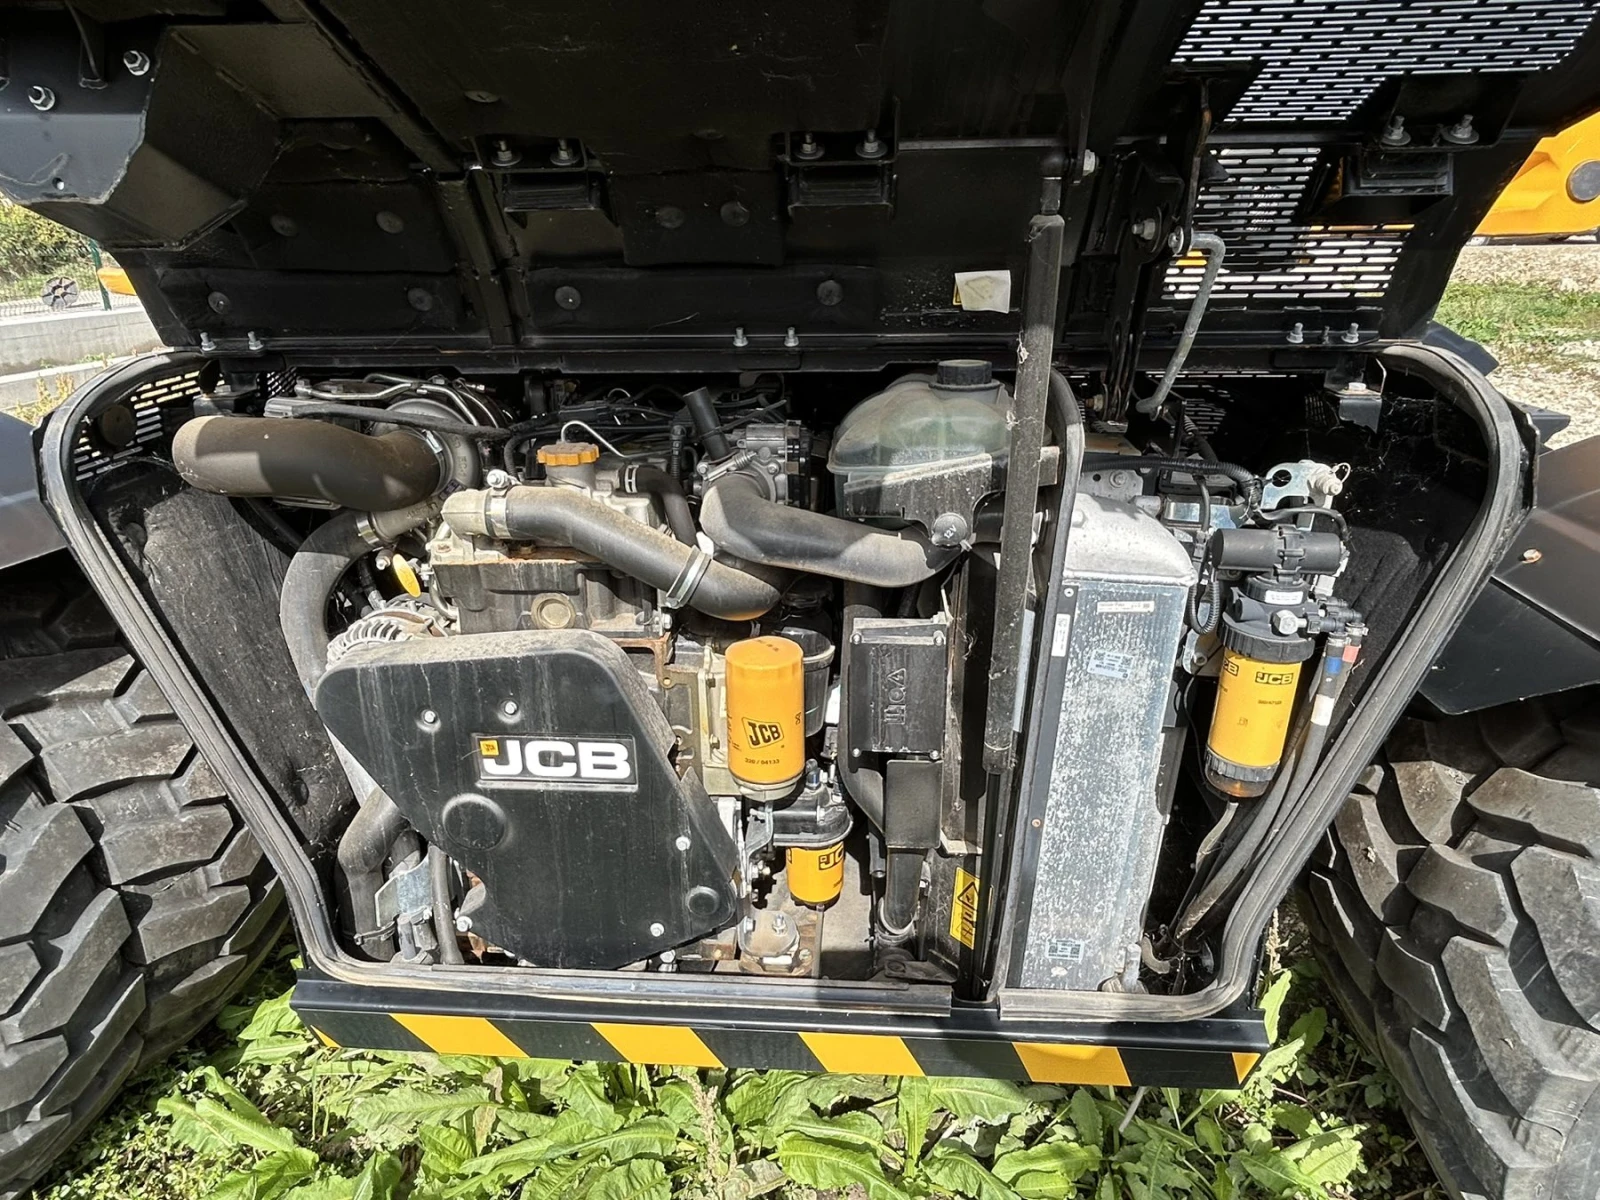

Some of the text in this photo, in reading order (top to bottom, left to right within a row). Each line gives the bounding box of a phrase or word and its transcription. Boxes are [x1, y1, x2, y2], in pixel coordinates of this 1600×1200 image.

[943, 524, 957, 539] 12V
[1256, 672, 1293, 685] JCB
[747, 721, 781, 746] JCB
[482, 739, 631, 780] JCB
